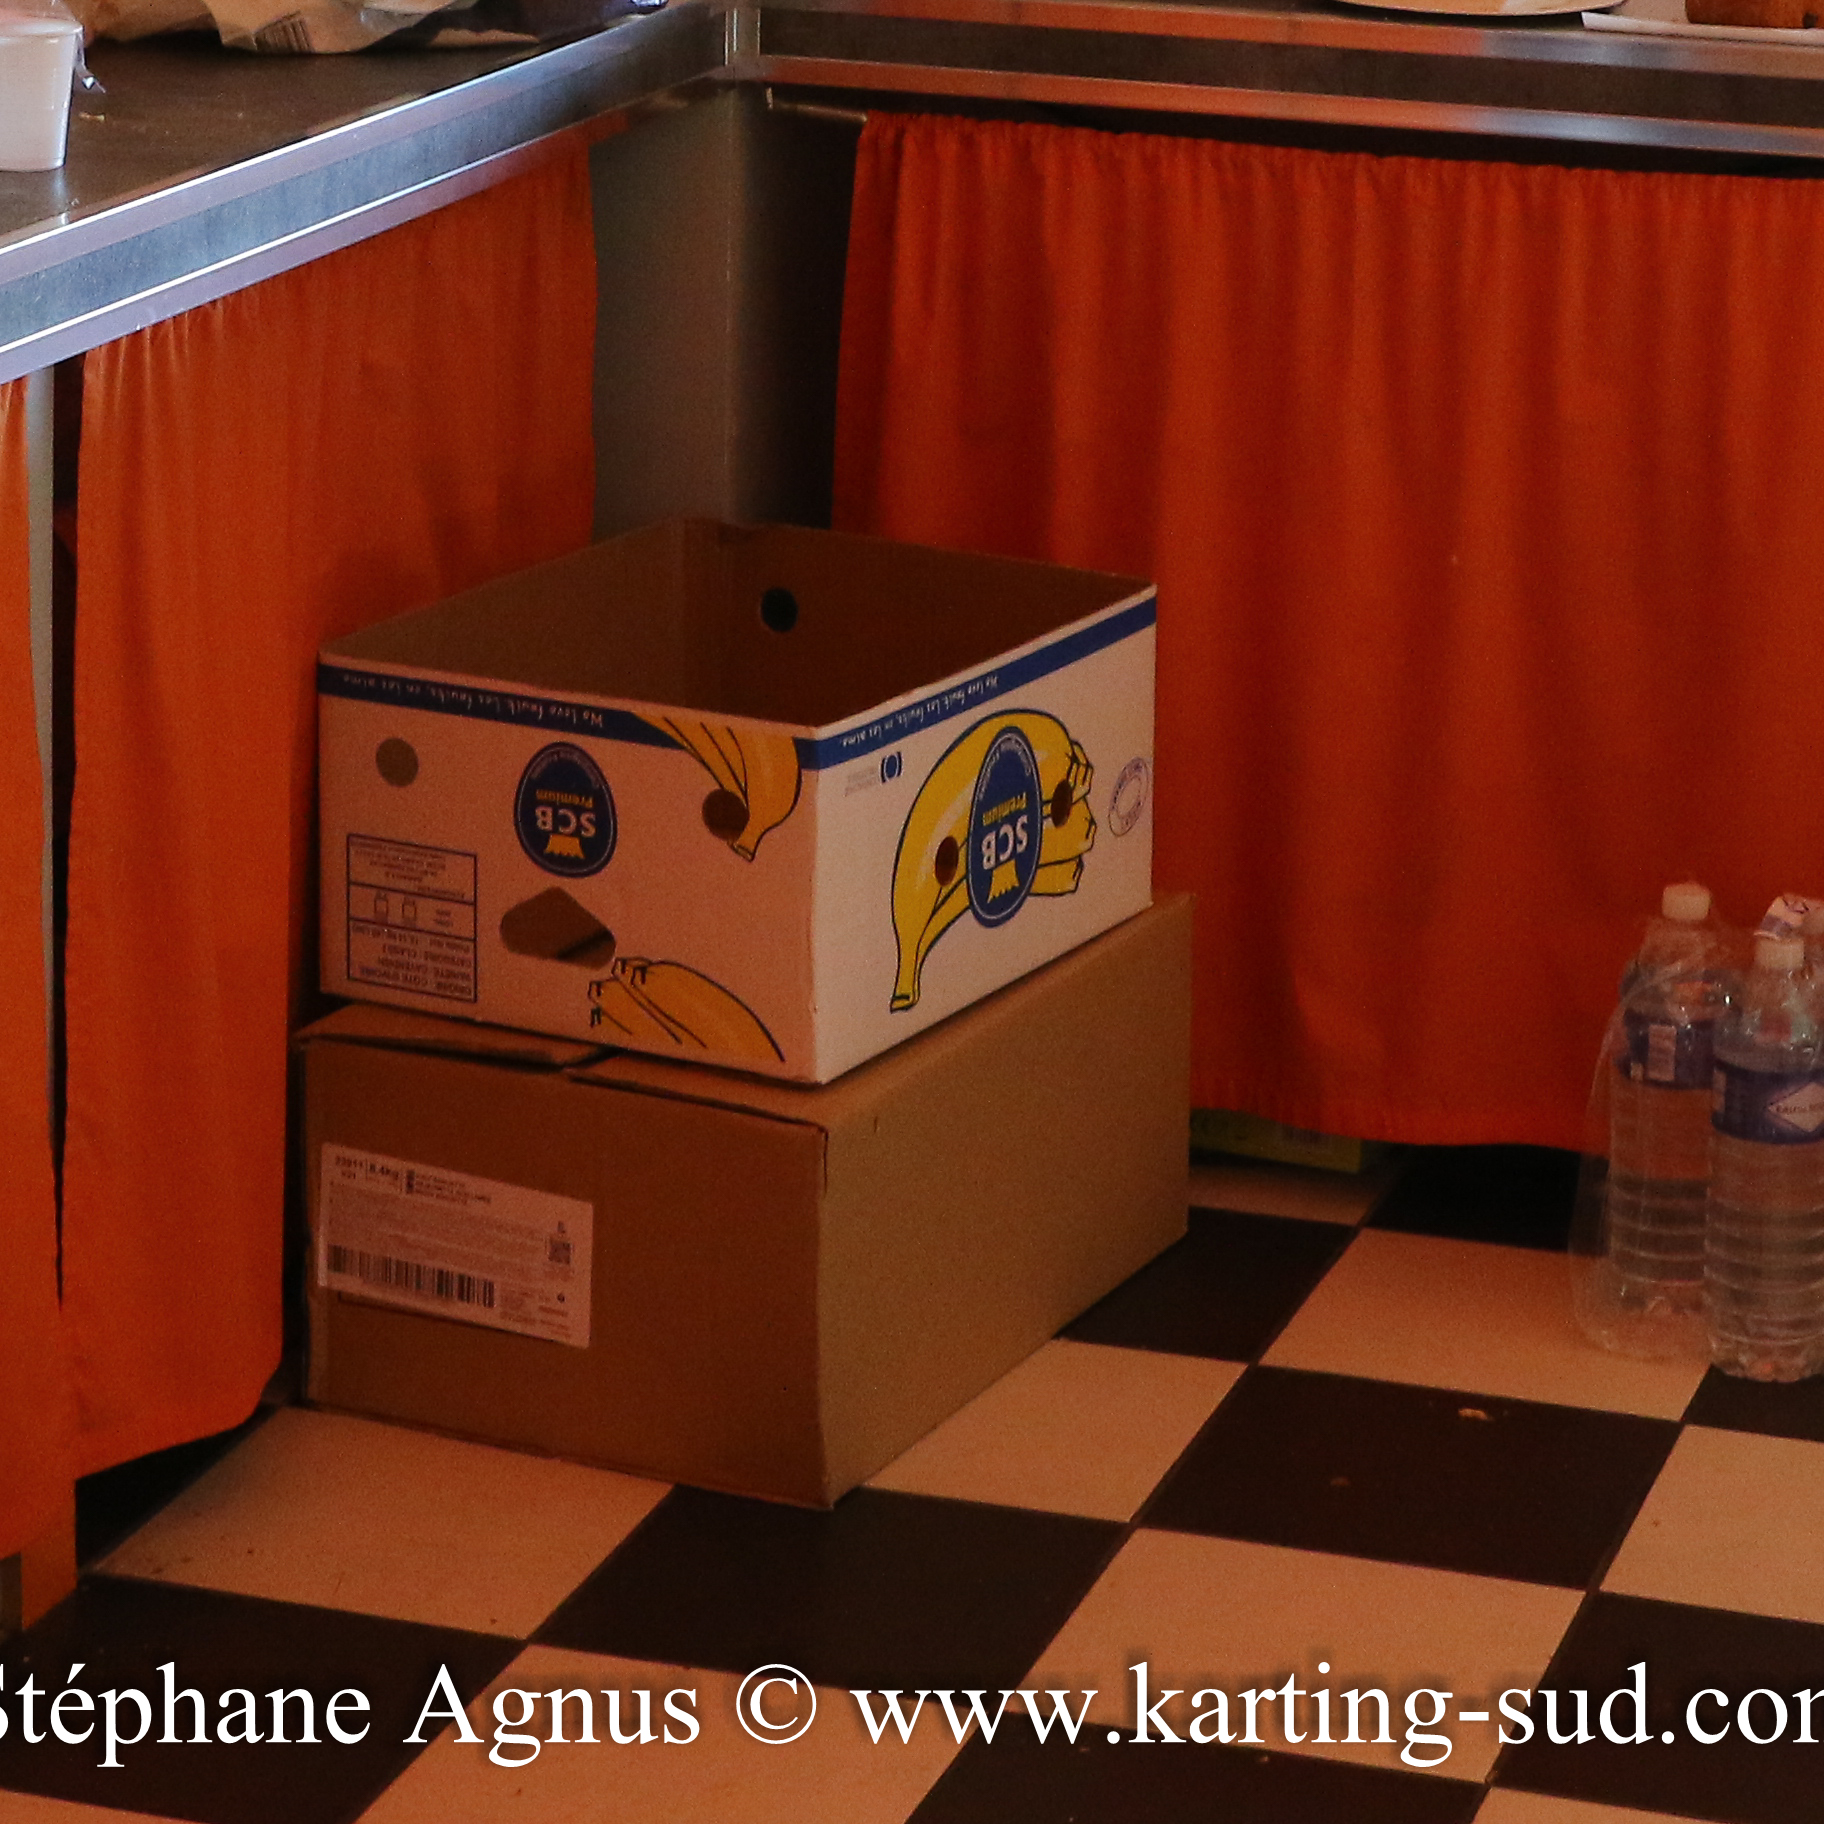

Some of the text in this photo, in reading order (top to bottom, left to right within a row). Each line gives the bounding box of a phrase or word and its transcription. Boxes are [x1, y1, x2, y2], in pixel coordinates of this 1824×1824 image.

[536, 789, 594, 808] Premium
[982, 792, 1028, 827] Premium
[535, 806, 596, 838] SCB
[981, 814, 1029, 870] SCB
